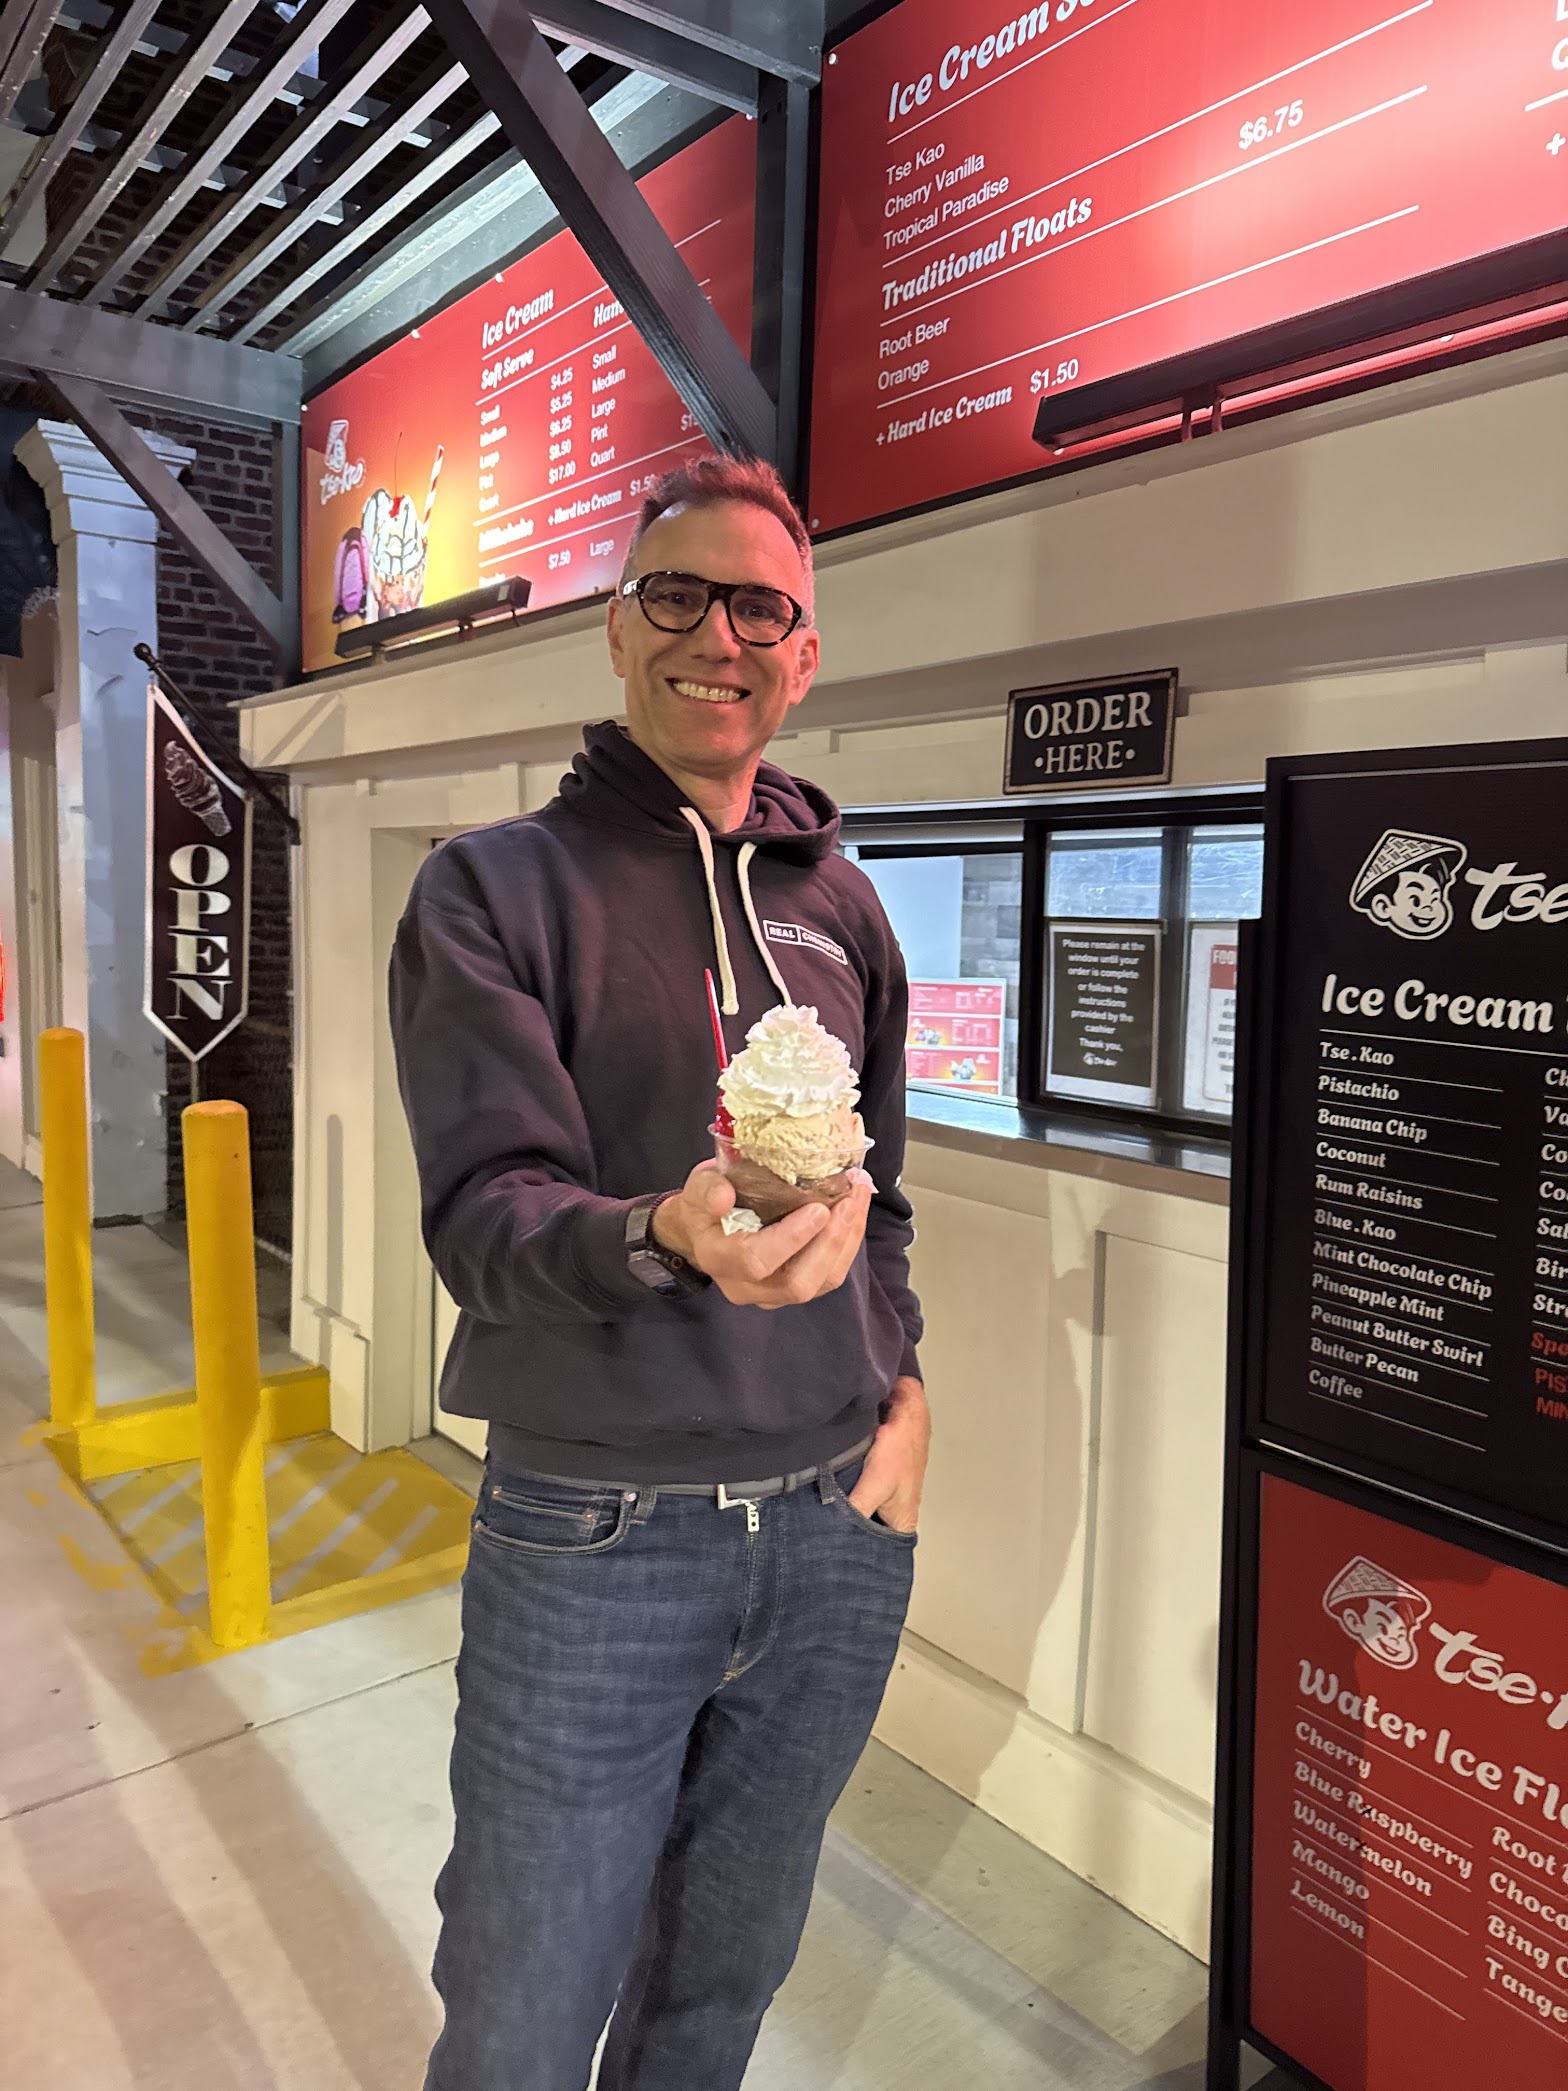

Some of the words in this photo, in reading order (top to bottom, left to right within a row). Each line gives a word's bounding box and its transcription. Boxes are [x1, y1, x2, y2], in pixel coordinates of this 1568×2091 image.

[888, 73, 932, 123] Ice
[938, 1, 1050, 91] Cream
[1239, 99, 1303, 151] $6.75
[886, 162, 912, 185] Tse
[915, 143, 945, 171] Kao
[884, 182, 932, 218] Cherry
[935, 154, 985, 192] Vanilla
[883, 212, 938, 250] Tropical
[942, 176, 1009, 222] Paradise
[882, 229, 1007, 310] Traditional
[1011, 197, 1093, 253] Floats
[482, 320, 504, 349] Ice
[505, 288, 554, 335] Cream
[592, 345, 617, 369] Small
[879, 331, 912, 359] Root
[915, 317, 950, 344] Beer
[481, 362, 503, 389] Soft
[503, 349, 534, 378] Serve
[550, 367, 573, 390] $4.25
[592, 368, 626, 394] Medium
[877, 359, 930, 390] Orange
[550, 391, 573, 414] $5.25
[591, 398, 616, 419] Large
[887, 411, 926, 443] Hard
[928, 406, 953, 429] Ice
[955, 385, 1012, 420] Cream
[1029, 358, 1079, 394] $1.50
[591, 424, 608, 444] Pint
[548, 461, 576, 485] $17.00
[590, 446, 616, 467] Quart
[576, 499, 591, 515] Ice
[591, 490, 622, 511] Cream
[548, 550, 571, 570] $7.50
[590, 539, 614, 557] Large
[1024, 691, 1153, 740] ORDER
[166, 843, 231, 1021] OPEN
[769, 927, 796, 939] REAL
[1062, 939, 1090, 949] Please
[1091, 941, 1120, 950] remain
[1120, 942, 1130, 951] at
[1131, 942, 1146, 951] the
[1067, 967, 1091, 976] order
[1091, 968, 1099, 977] is
[1100, 969, 1139, 979] complete
[1068, 953, 1099, 963] window
[1100, 955, 1119, 964] until
[1119, 957, 1139, 966] your
[1077, 983, 1087, 991] or
[1088, 982, 1112, 993] follow
[1113, 985, 1128, 994] the
[1078, 996, 1127, 1008] instructions
[1321, 974, 1386, 1017] Ice
[1394, 979, 1554, 1033] Cream
[1071, 1010, 1106, 1020] provided
[1107, 1012, 1119, 1022] by
[1119, 1013, 1134, 1022] the
[1079, 1037, 1104, 1049] Thank
[1318, 1075, 1400, 1101] Pistachio
[1317, 1108, 1383, 1134] Banana
[1385, 1119, 1428, 1143] Chip
[1316, 1141, 1386, 1168] Coconut
[1315, 1174, 1353, 1195] Rum
[1356, 1181, 1424, 1210] Raisins
[1313, 1240, 1355, 1265] Mint
[1356, 1251, 1445, 1287] Chocolate
[1448, 1274, 1493, 1301] Chip
[1311, 1272, 1398, 1309] Pineapple
[1399, 1295, 1445, 1322] Mint
[1310, 1304, 1370, 1335] Peanut
[1372, 1322, 1430, 1351] Butter
[1432, 1338, 1484, 1367] Swirl
[1310, 1336, 1364, 1365] Butter
[1365, 1352, 1420, 1383] Pecan
[1308, 1368, 1364, 1399] Coffee
[1299, 1659, 1427, 1749] Water
[1434, 1729, 1503, 1791] Ice
[1295, 1721, 1372, 1780] Cherry
[1294, 1760, 1344, 1802] Blue
[1347, 1790, 1473, 1879] Raspberry
[1293, 1799, 1433, 1897] Watermelon
[1492, 1825, 1557, 1876] Root
[1292, 1839, 1371, 1900] Mango
[1290, 1879, 1365, 1940] Lemon
[1486, 1914, 1550, 1970] Bing
